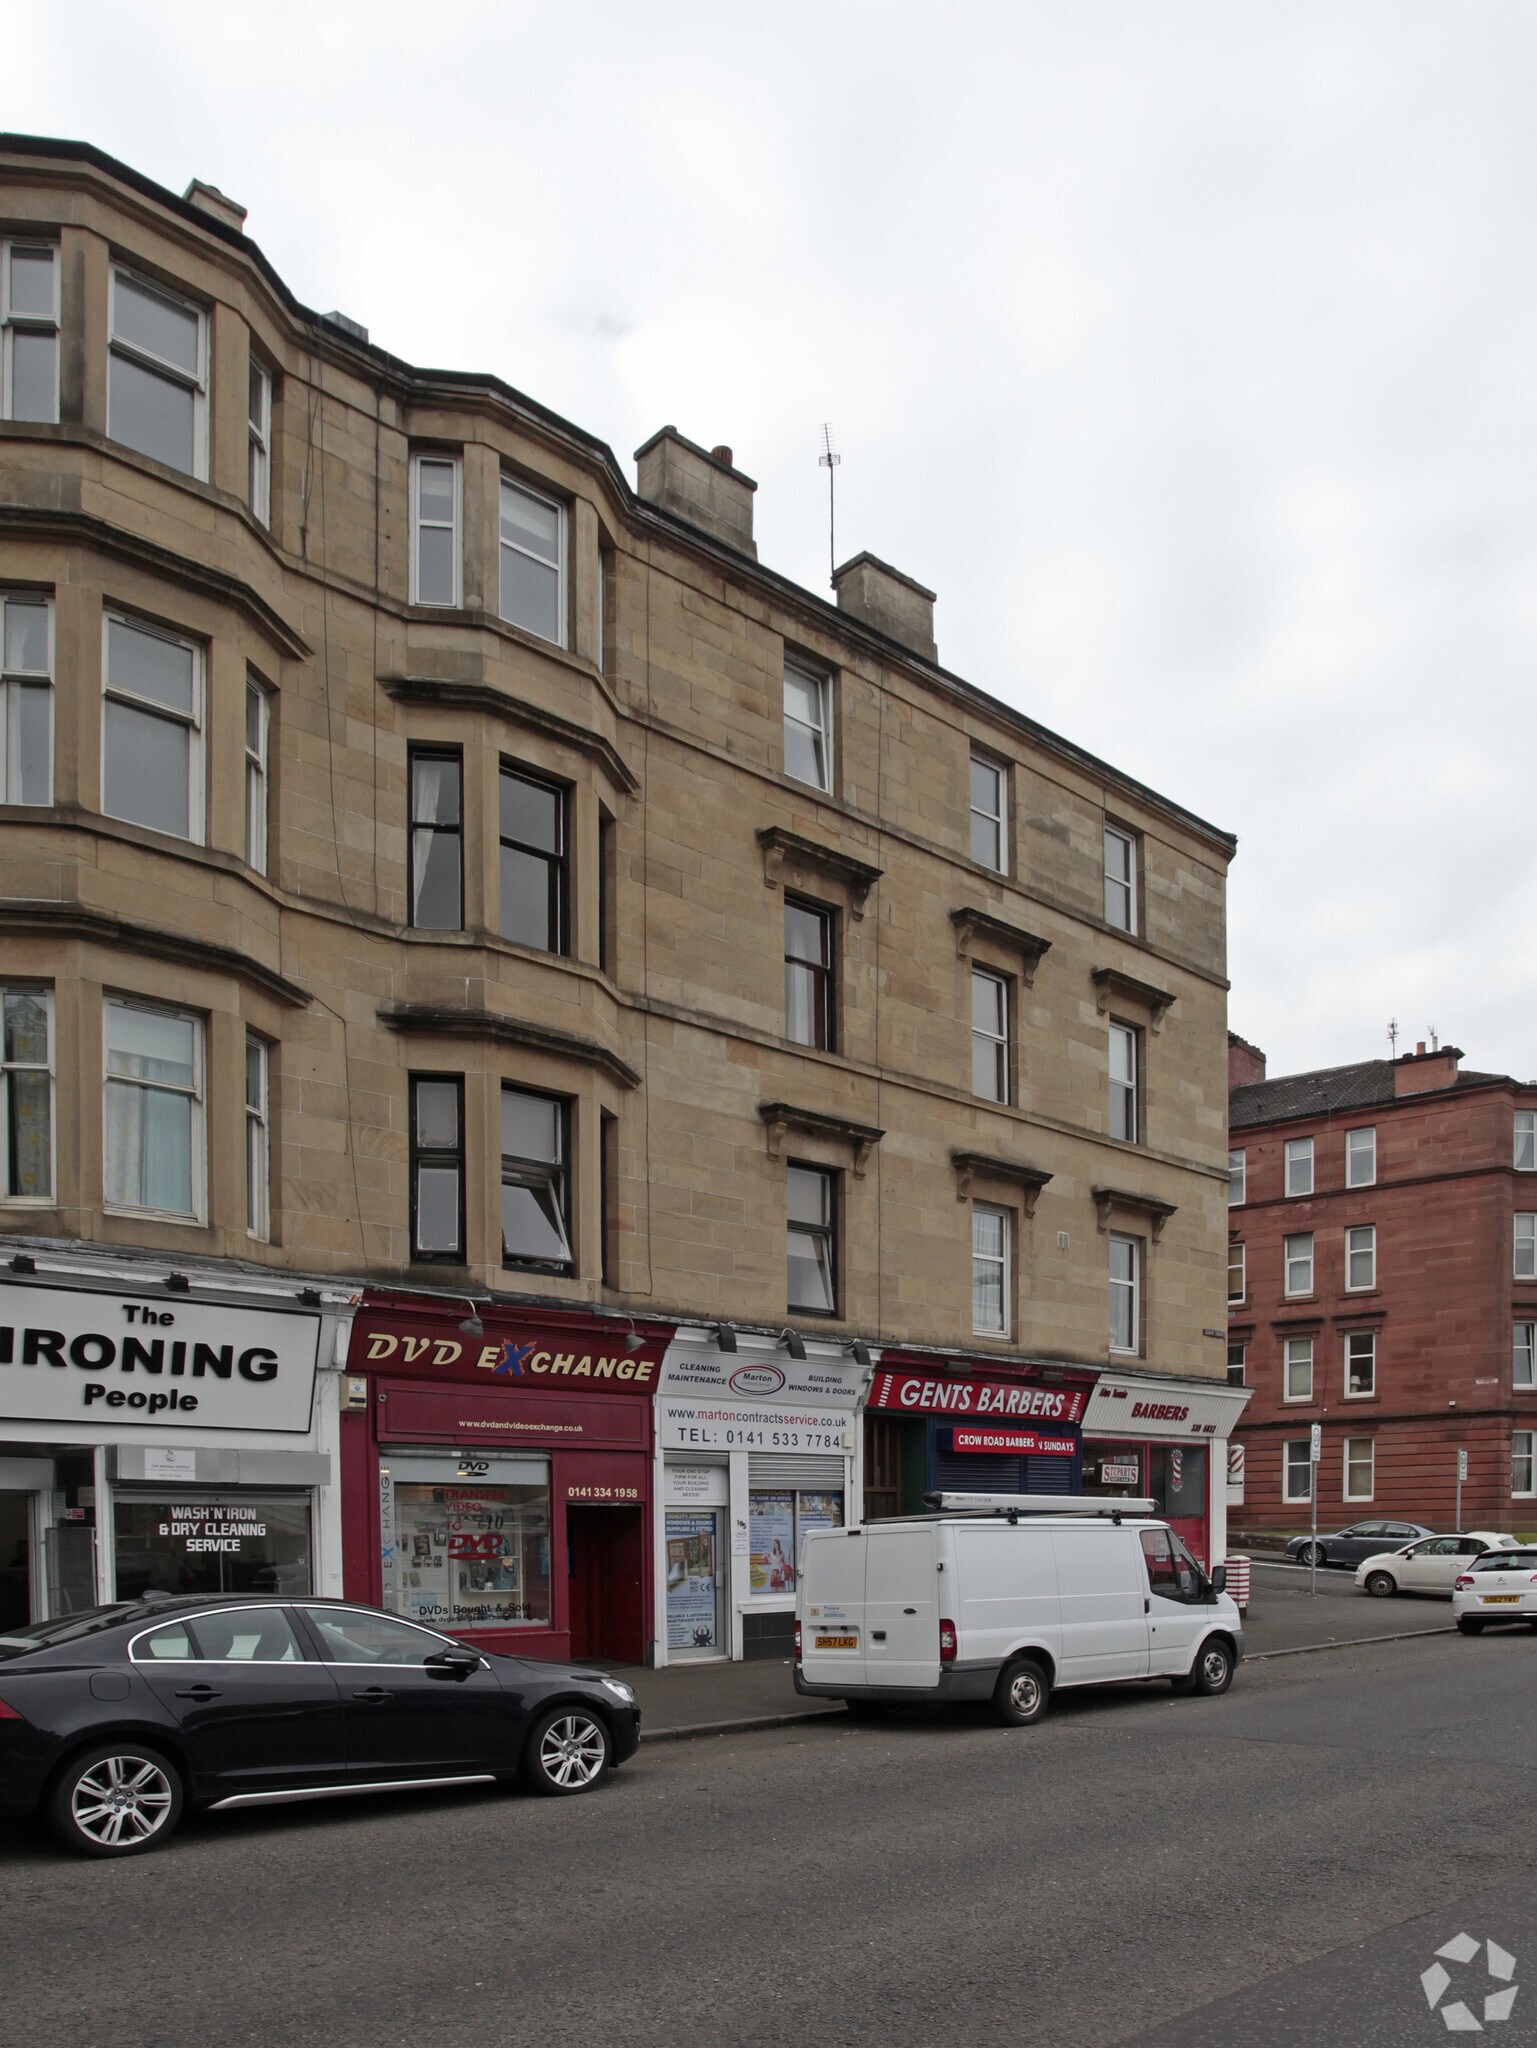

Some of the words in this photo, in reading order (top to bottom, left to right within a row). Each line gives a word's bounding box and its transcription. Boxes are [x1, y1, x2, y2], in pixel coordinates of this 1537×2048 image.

[122, 1304, 175, 1326] The
[0, 1326, 278, 1382] IRONING
[366, 1333, 462, 1365] DVD
[477, 1338, 655, 1381] EXCHANGE
[679, 1363, 721, 1373] CLEANING
[667, 1373, 727, 1385] MAINTENANCE
[743, 1372, 772, 1382] Marton
[808, 1375, 842, 1384] BUILDING
[788, 1383, 824, 1393] WINDOWS
[833, 1387, 856, 1396] DOORS
[84, 1383, 198, 1414] People
[900, 1379, 974, 1411] GENTS
[976, 1387, 1066, 1417] BARBERS
[667, 1408, 847, 1427] www.martoncontractsservice.co.uk
[1131, 1402, 1189, 1421] BARBERS
[459, 1420, 583, 1433] www.dvdandvideoexchange.co.uk
[678, 1427, 717, 1442] TEL:
[726, 1430, 763, 1444] 0141
[772, 1433, 799, 1446] 533
[806, 1434, 840, 1448] 7784
[958, 1435, 981, 1445] CROW
[984, 1435, 1005, 1446] ROAD
[1006, 1437, 1035, 1448] BARBERS
[1044, 1440, 1074, 1452] SUNDAYS
[458, 1461, 489, 1471] DVD
[444, 1488, 506, 1500] TRANSFER
[568, 1487, 592, 1497] 0141
[594, 1487, 611, 1497] 334
[614, 1488, 638, 1498] 1958
[444, 1502, 482, 1512] VIDEO
[159, 1523, 169, 1535] &
[171, 1523, 200, 1535] DRY
[205, 1523, 266, 1536] CLEANING
[445, 1520, 463, 1531] TO
[186, 1538, 240, 1552] SERVICE
[448, 1534, 503, 1550] DVD
[419, 1605, 448, 1615] DVDs
[453, 1603, 491, 1614] Bought
[495, 1603, 502, 1612] &
[508, 1602, 531, 1612] Sold
